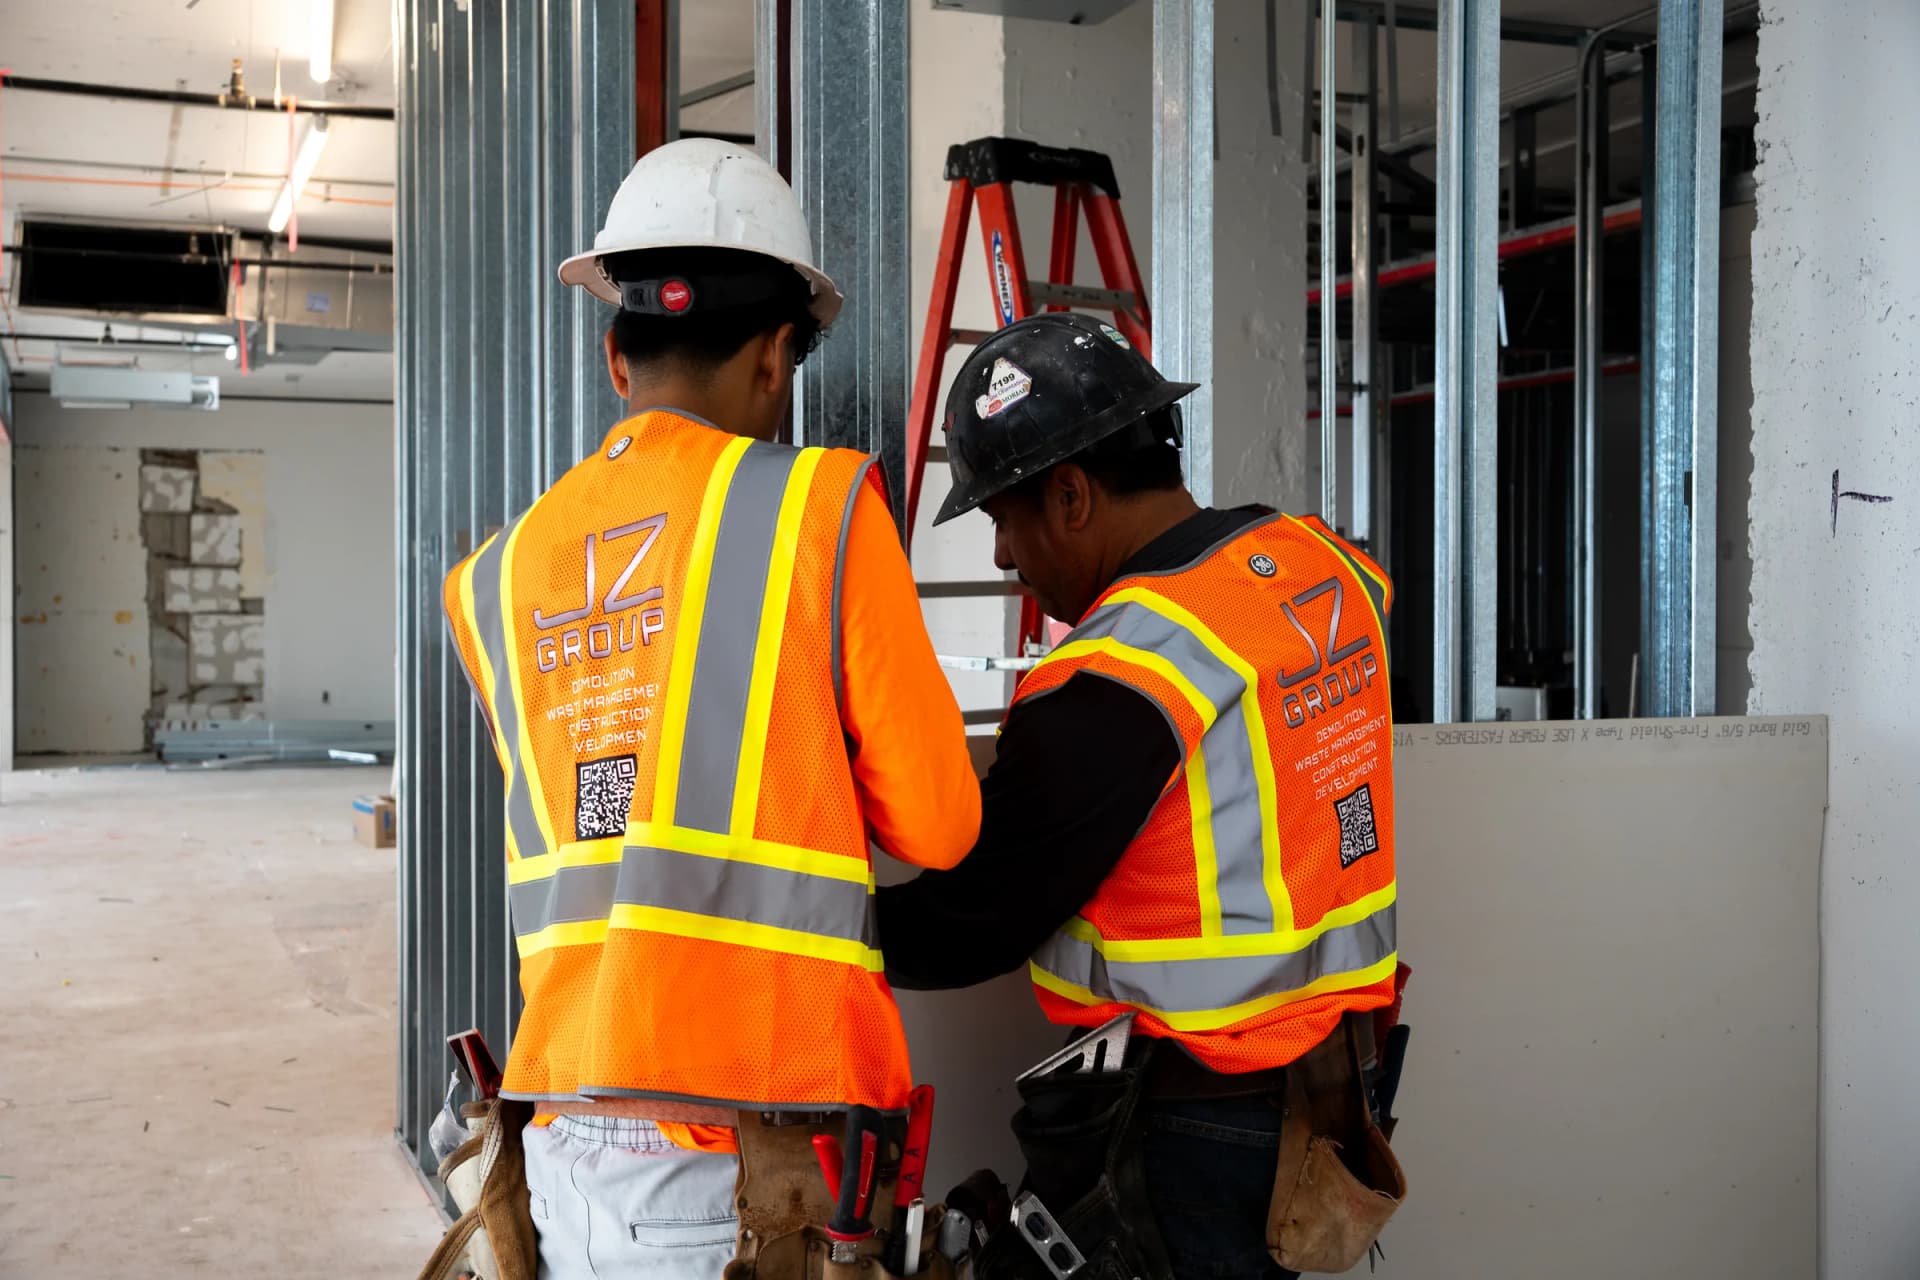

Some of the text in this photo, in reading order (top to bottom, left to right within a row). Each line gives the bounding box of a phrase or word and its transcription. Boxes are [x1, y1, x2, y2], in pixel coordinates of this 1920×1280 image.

[992, 373, 1015, 391] 7199
[533, 512, 668, 630] JZ
[536, 607, 664, 673] GROUP
[1277, 576, 1371, 688] JZ
[1282, 652, 1377, 729] GROUP
[546, 700, 581, 720] WAST
[1316, 706, 1367, 744] DEMOLITION
[1295, 714, 1386, 773] WASTE MANAGEMENT
[1436, 730, 1505, 745] FASTENERS
[1552, 727, 1575, 742] USE
[1581, 728, 1590, 741] X
[1595, 726, 1623, 740] Type
[1631, 724, 1709, 739] Fire-Shield
[1312, 739, 1377, 784] CONSTRUCTION
[1315, 756, 1378, 800] DEVELOPMENT
